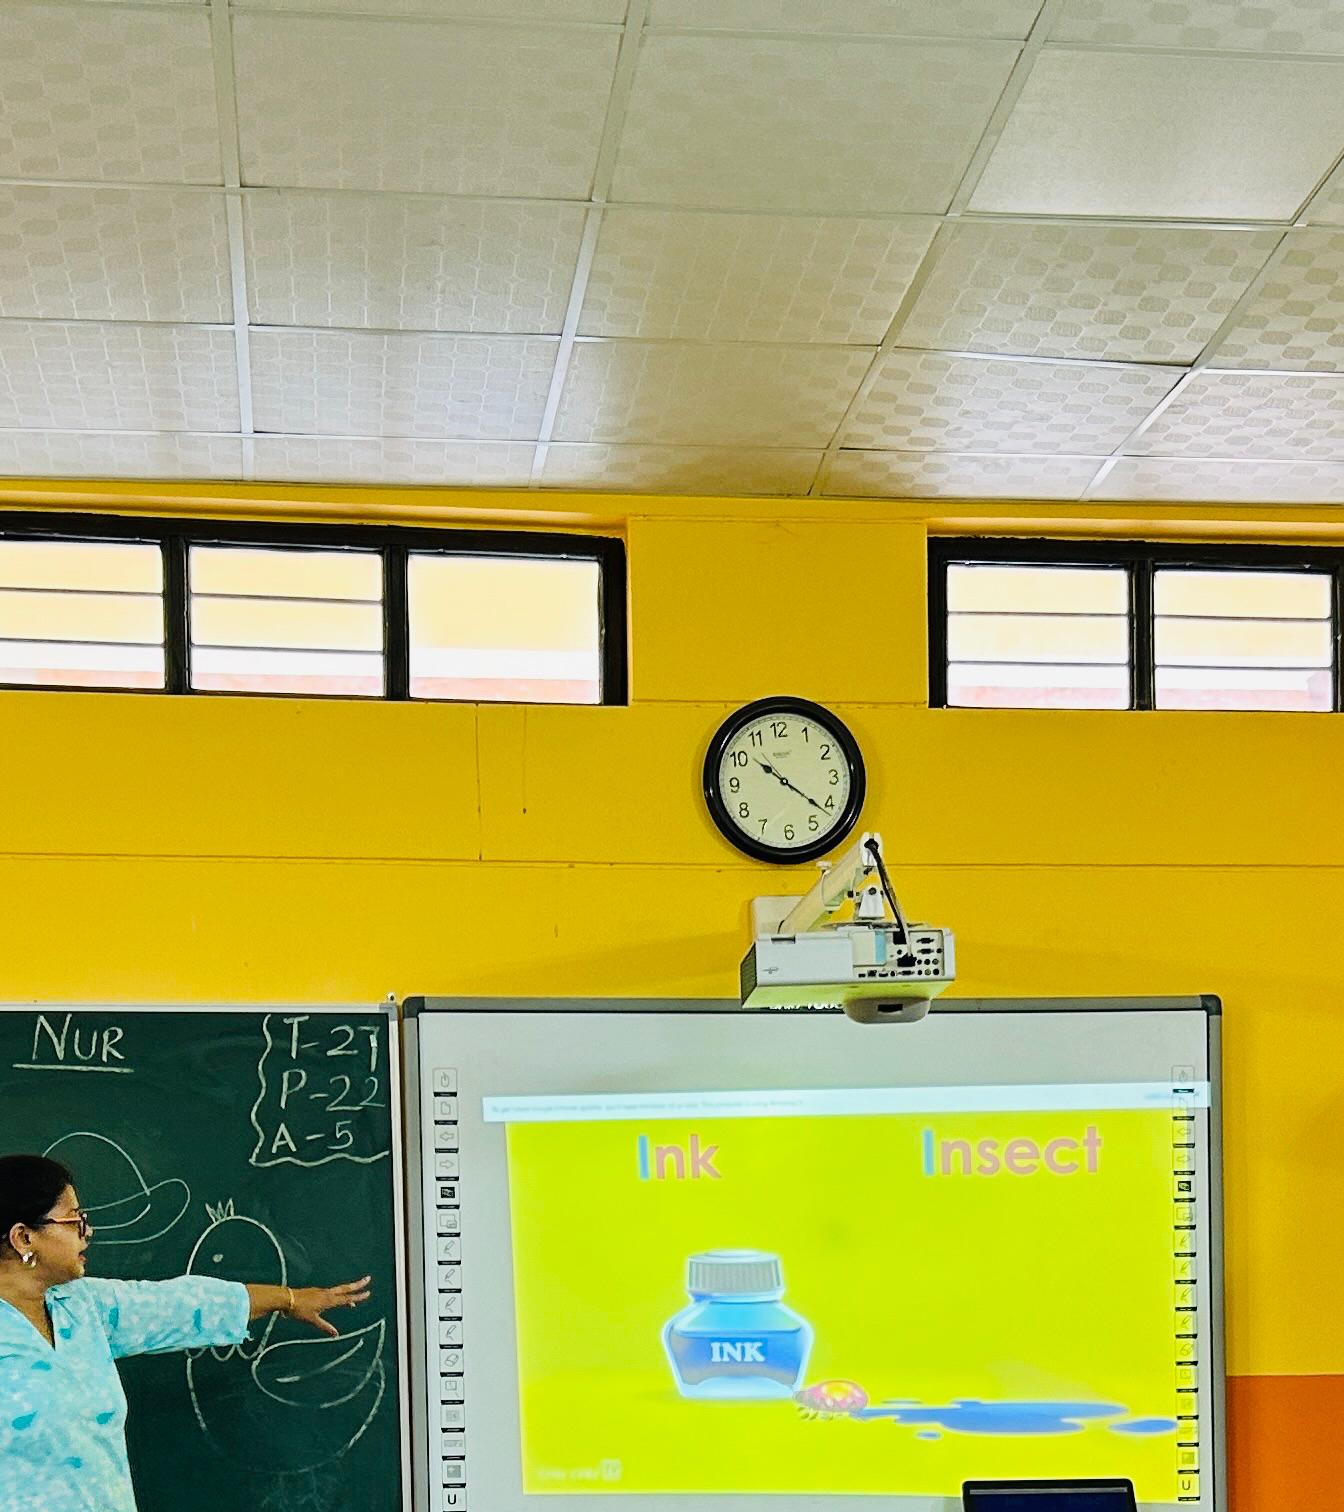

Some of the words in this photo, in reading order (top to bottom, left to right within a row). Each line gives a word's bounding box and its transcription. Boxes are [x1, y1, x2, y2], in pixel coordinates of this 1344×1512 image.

[769, 721, 788, 738] 12
[801, 727, 809, 743] 1
[748, 730, 763, 747] 11
[729, 750, 748, 767] 10
[819, 744, 831, 760] 2
[729, 777, 740, 793] 9
[828, 769, 839, 785] 3
[738, 802, 750, 818] 8
[824, 795, 835, 810] 4
[758, 818, 768, 835] 7
[808, 815, 819, 831] 5
[783, 824, 795, 840] 6
[31, 1013, 125, 1063] NUR
[637, 1133, 723, 1181] Ink
[921, 1126, 1103, 1177] Insect
[710, 1341, 766, 1363] INK
